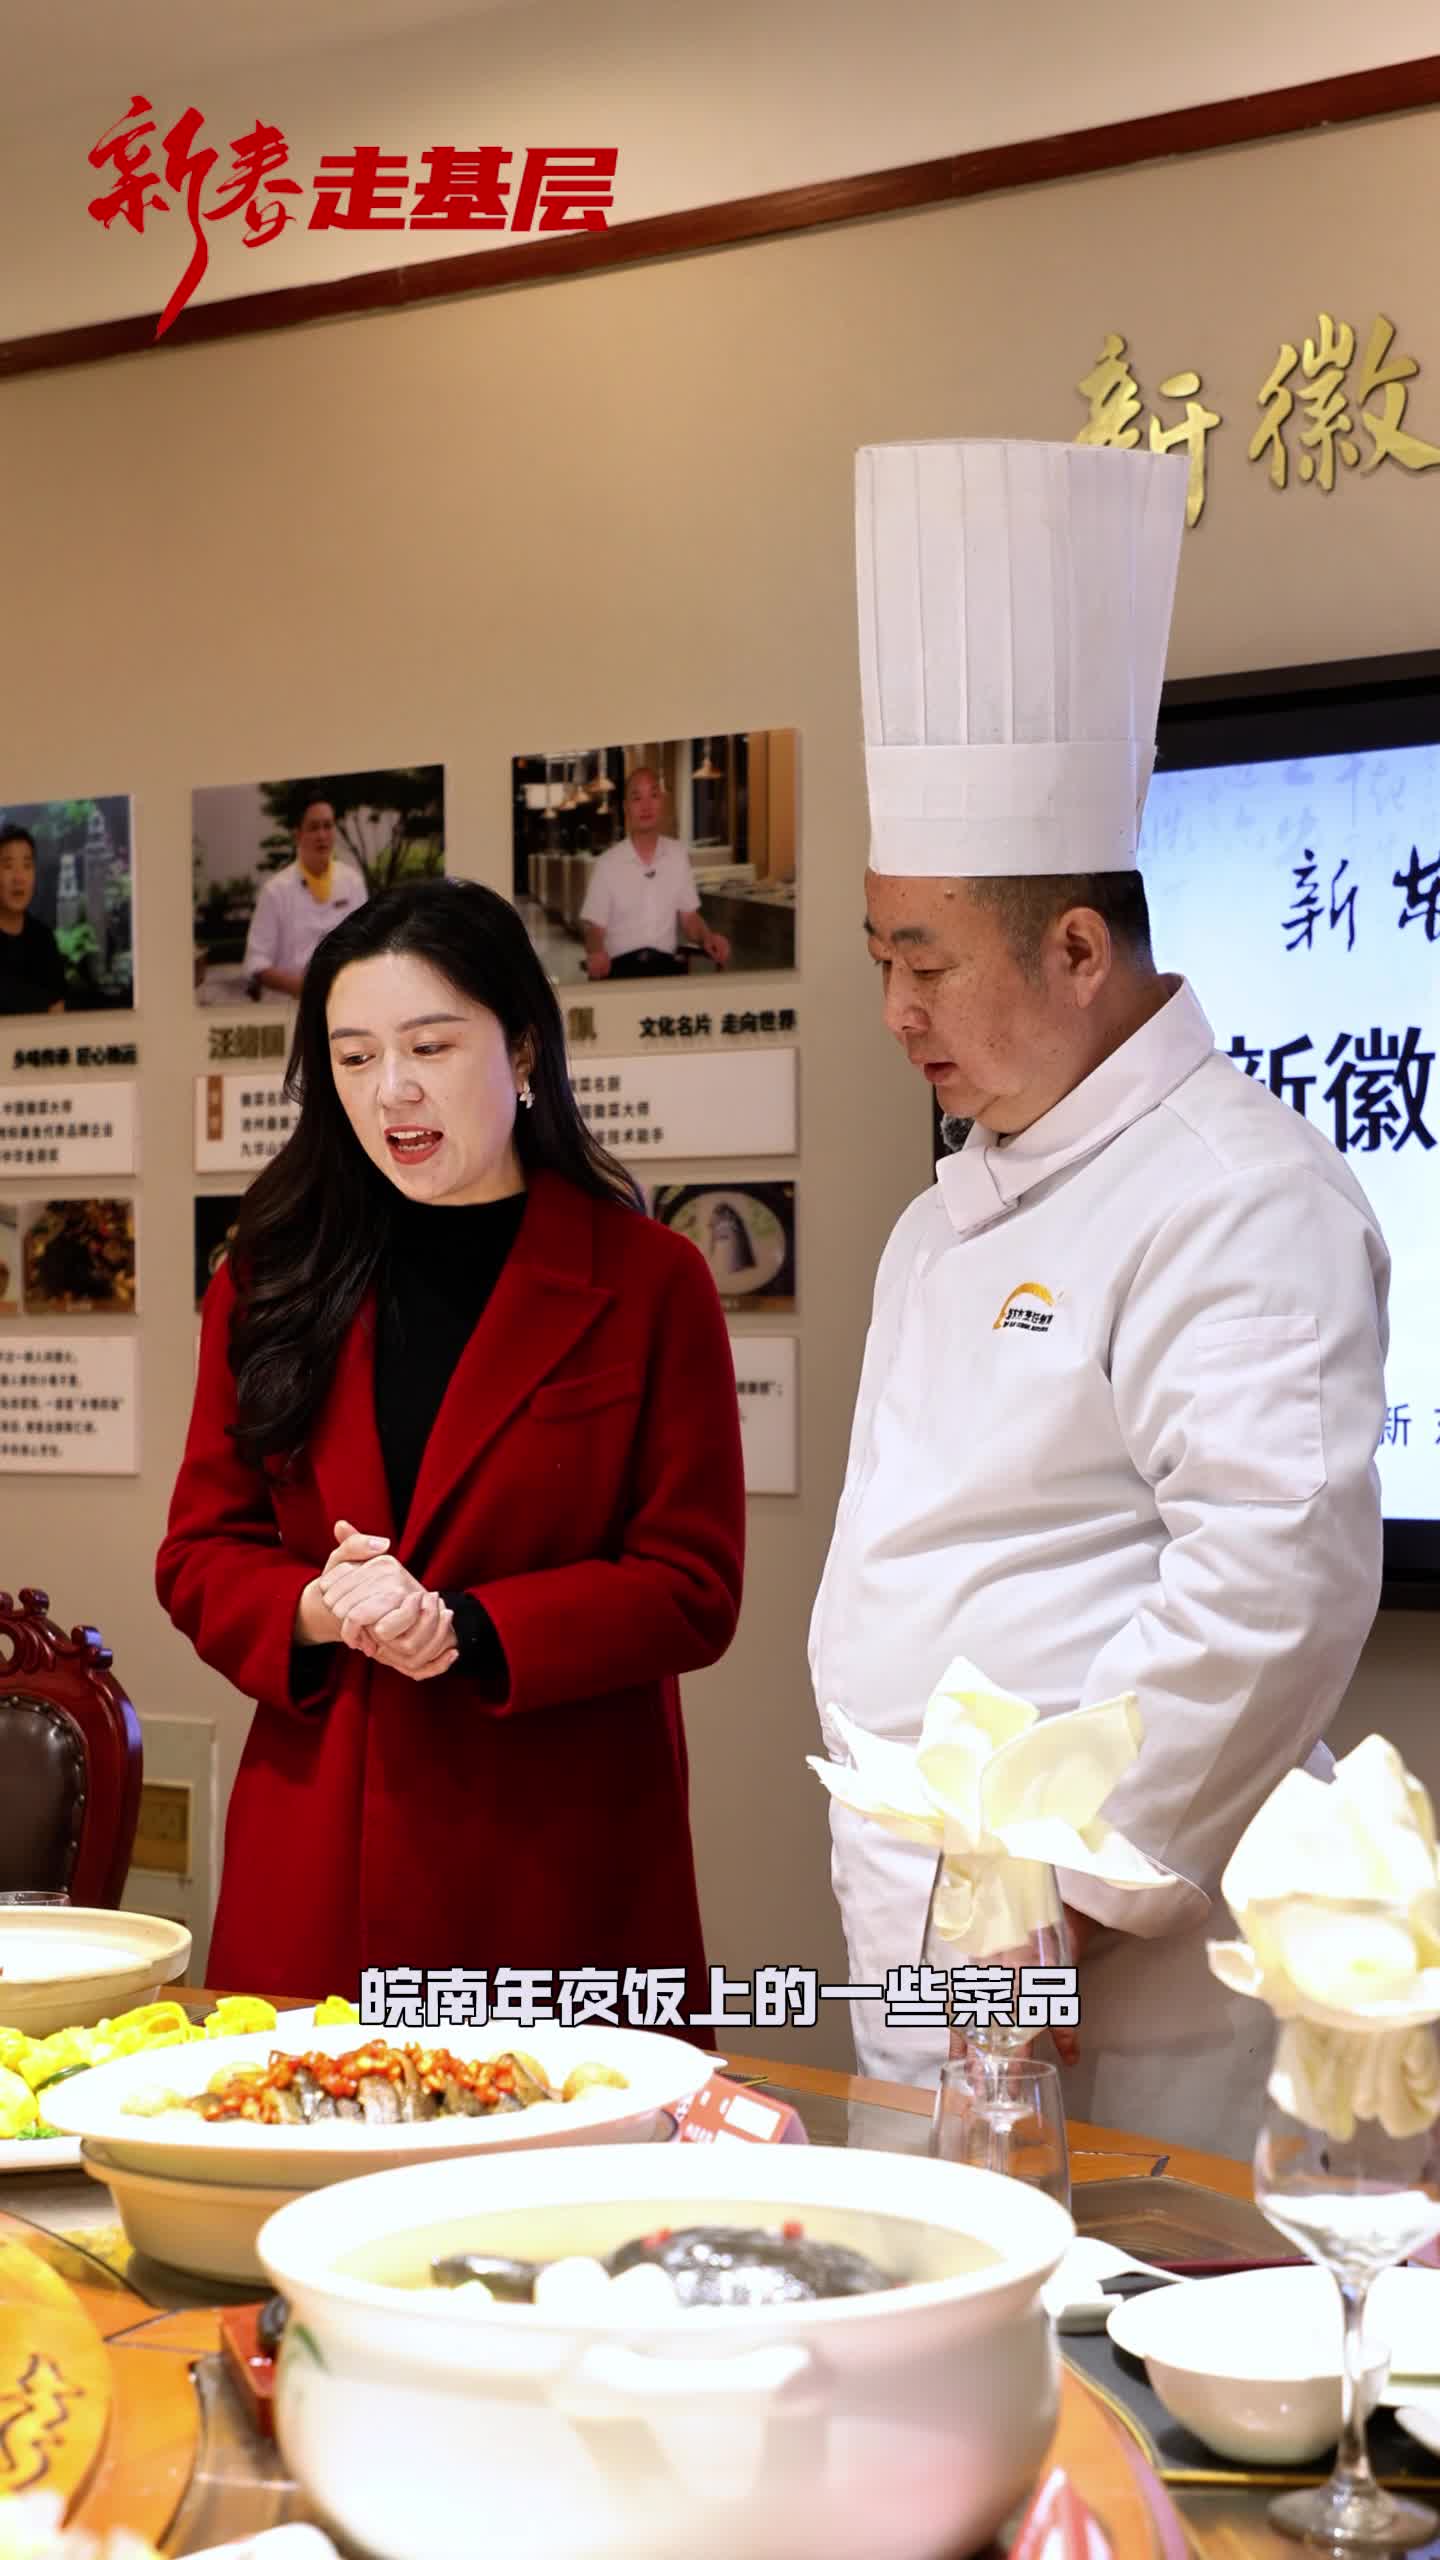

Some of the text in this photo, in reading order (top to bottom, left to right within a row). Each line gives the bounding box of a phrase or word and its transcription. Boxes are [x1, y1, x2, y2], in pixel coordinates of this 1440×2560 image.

[640, 1009, 797, 1039] 文化名片 走向世界
